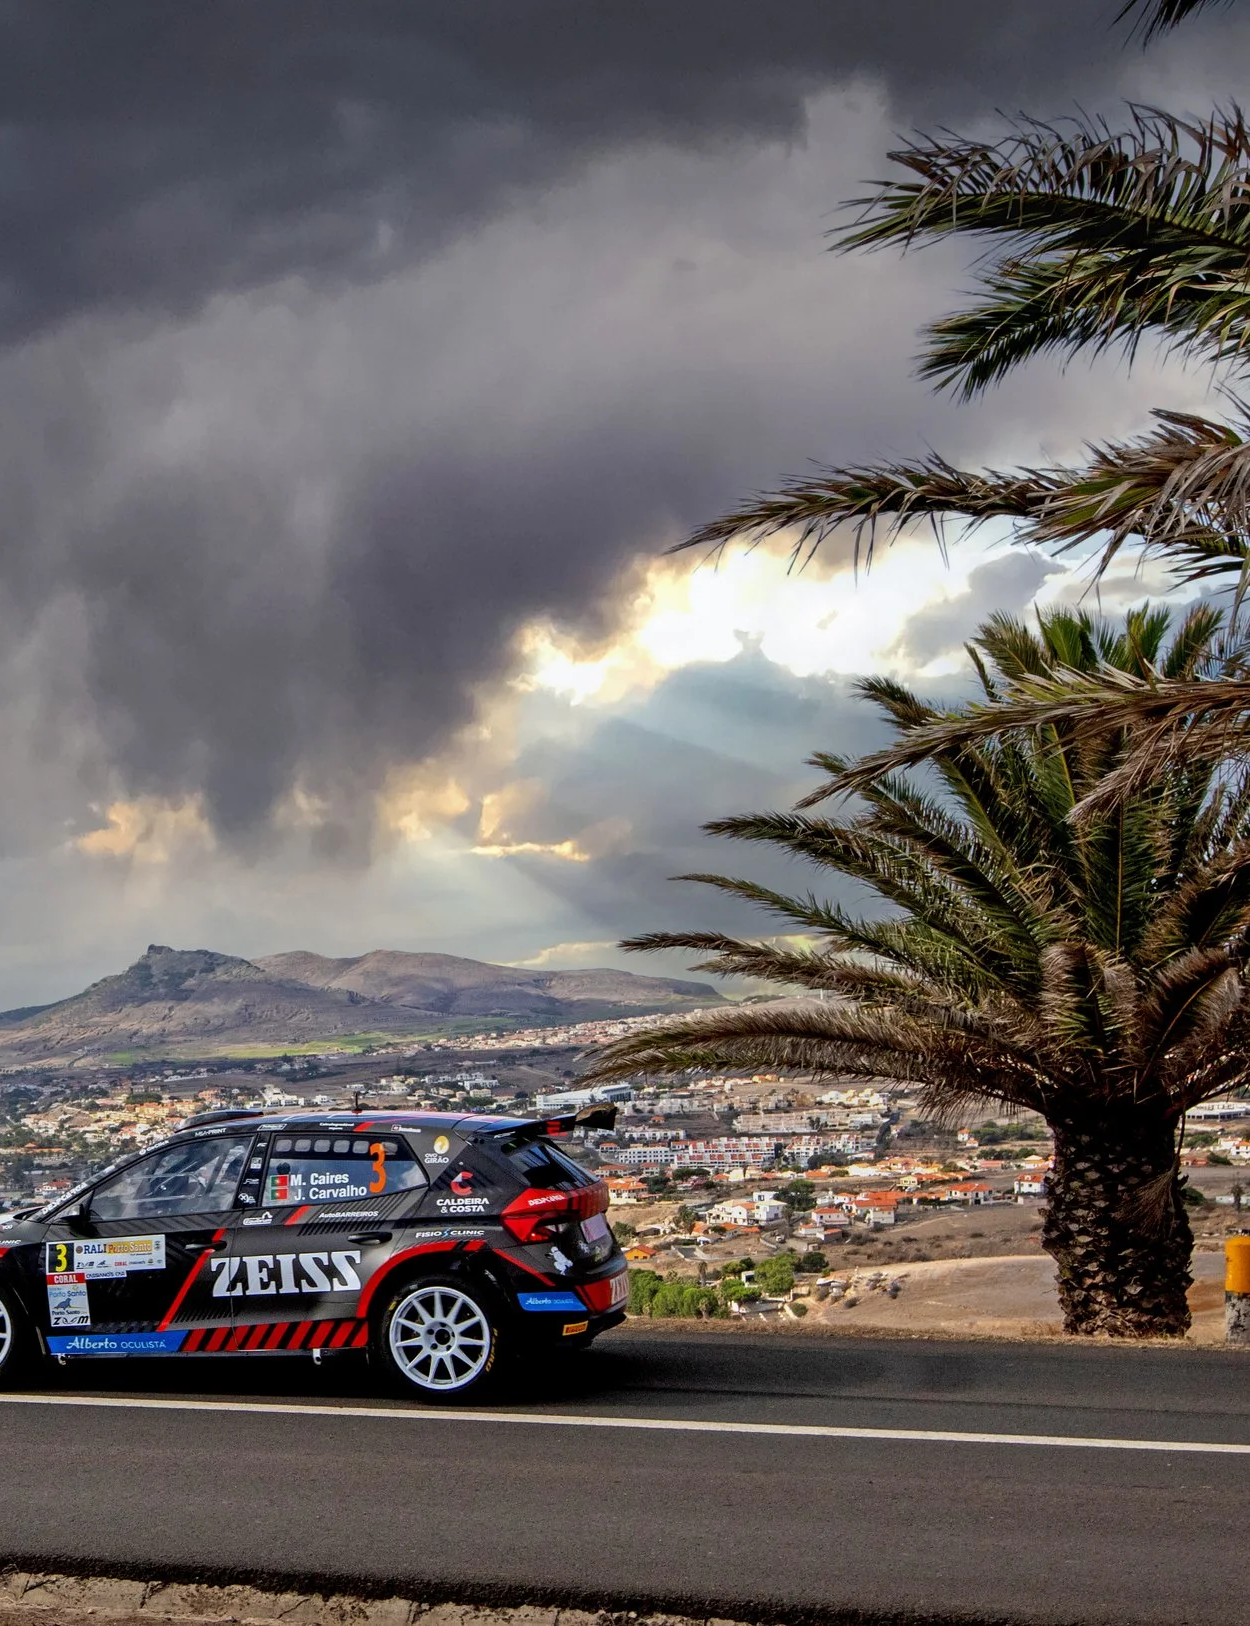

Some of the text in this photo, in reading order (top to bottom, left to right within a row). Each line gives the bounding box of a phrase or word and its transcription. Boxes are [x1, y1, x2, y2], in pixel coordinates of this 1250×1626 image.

[424, 1156, 449, 1164] GIRÃO
[369, 1142, 387, 1193] 3
[290, 1172, 349, 1186] M. Caires
[294, 1184, 367, 1200] J. Carvalho
[436, 1198, 490, 1206] CALDEIRA
[318, 1210, 379, 1218] AutoBARREIROS
[449, 1205, 485, 1213] COSTA
[83, 1241, 151, 1254] RALI Porto Santo
[55, 1244, 68, 1272] 3
[54, 1275, 78, 1284] CORAL
[210, 1250, 362, 1297] ZEISS
[66, 1337, 166, 1349] Alberto OCULISTA
